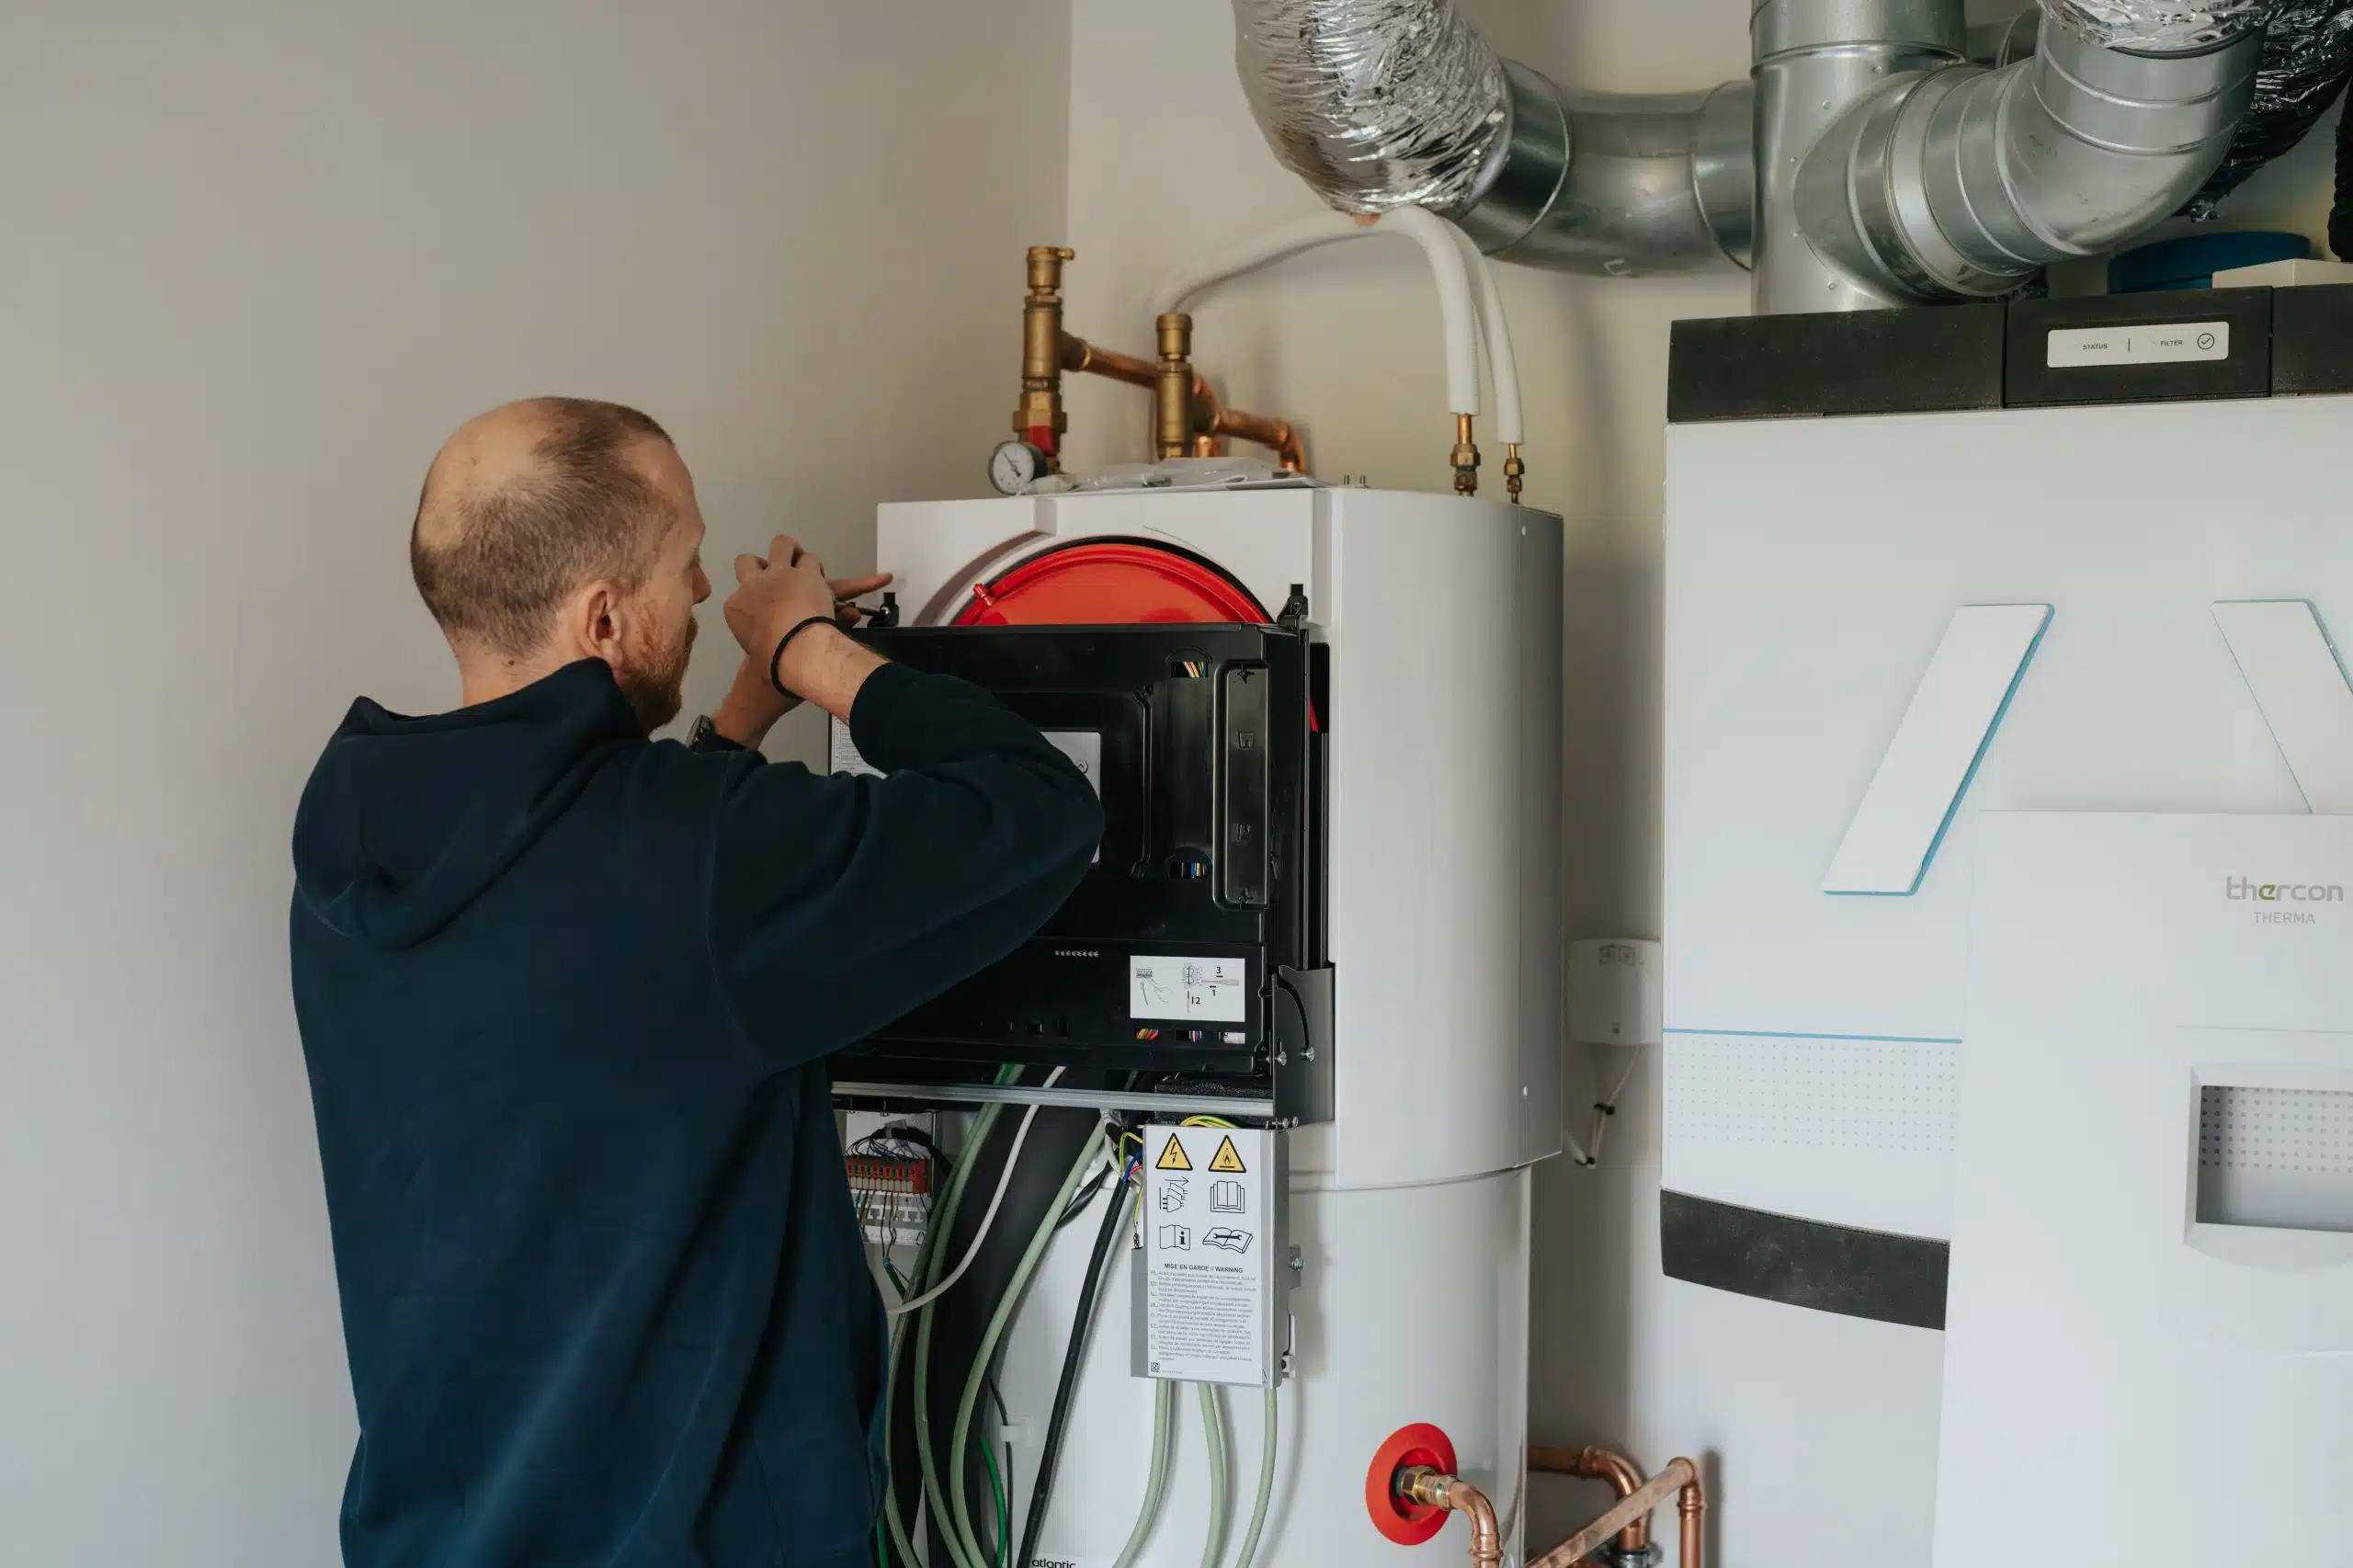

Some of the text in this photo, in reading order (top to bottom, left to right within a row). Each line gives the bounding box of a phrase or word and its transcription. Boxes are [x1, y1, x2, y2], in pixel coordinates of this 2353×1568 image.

[2226, 875, 2345, 902] thercon
[2253, 912, 2316, 924] THERMA
[1216, 966, 1222, 974] 3
[1031, 1558, 1076, 1568] atlantic
